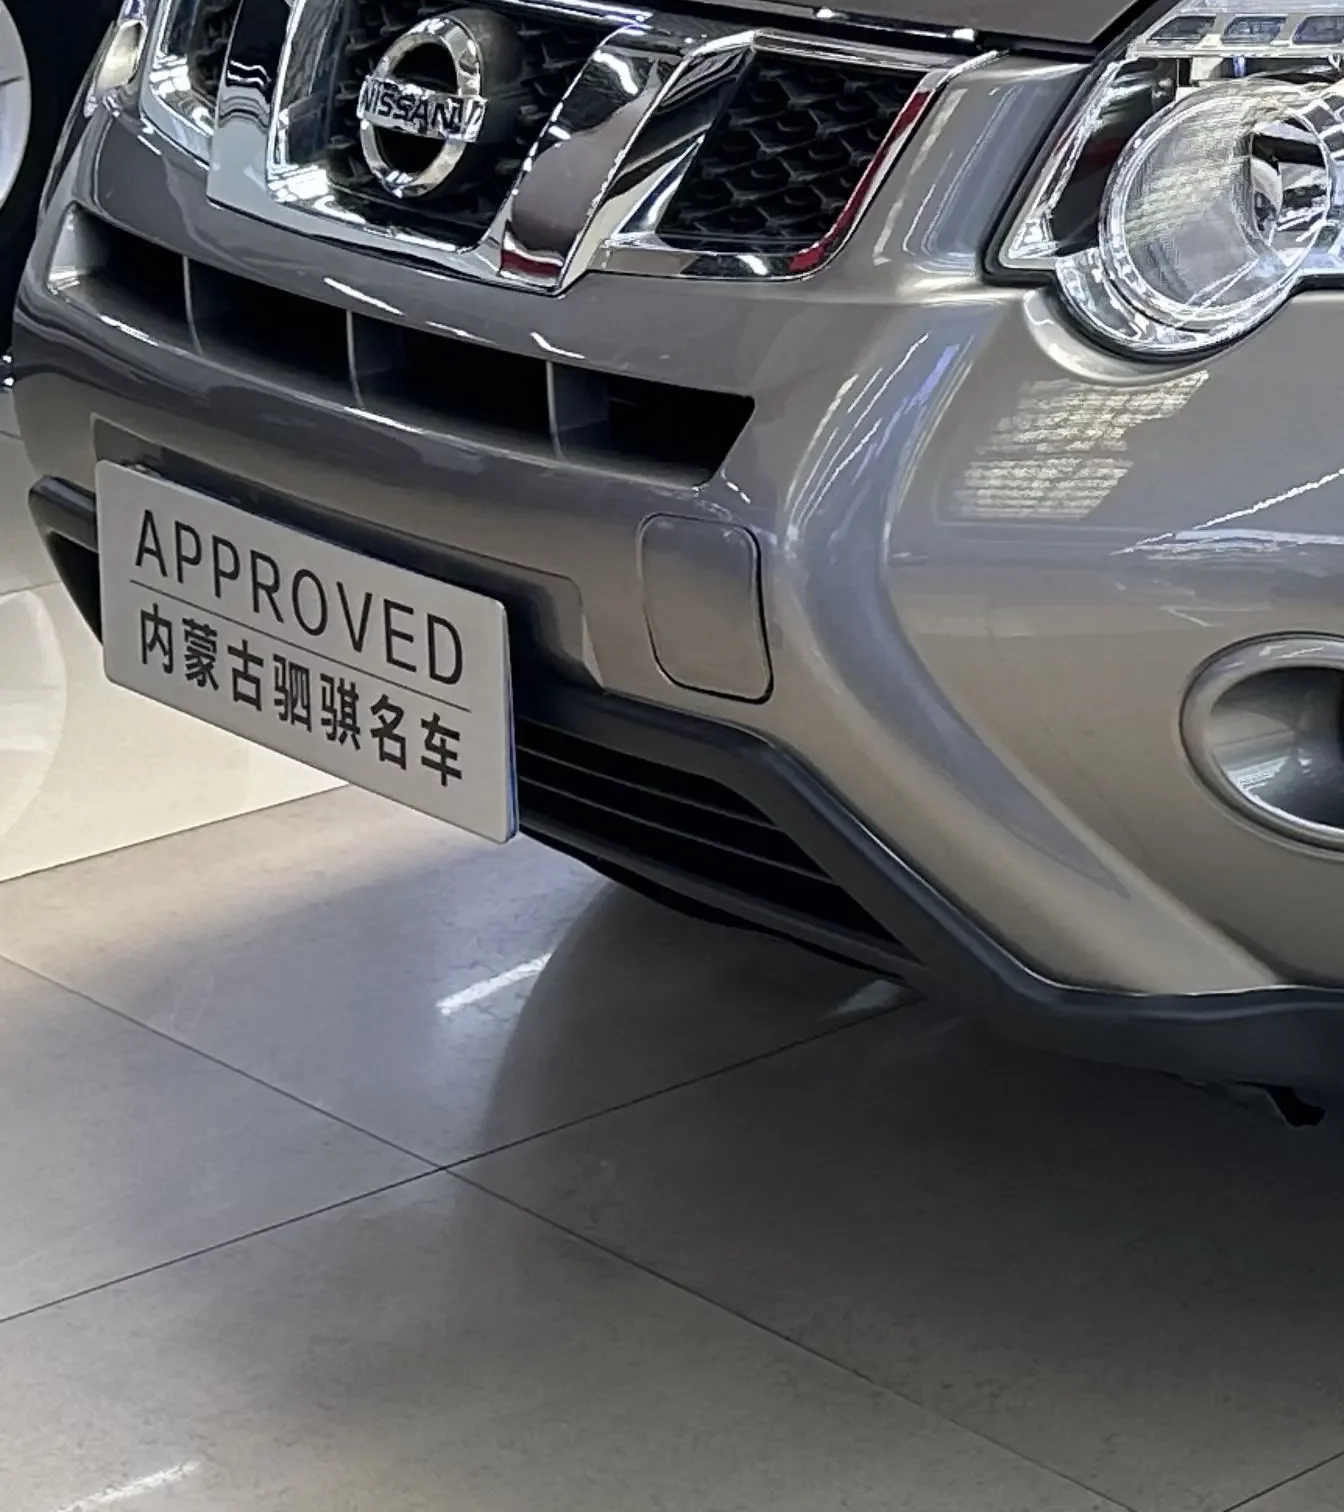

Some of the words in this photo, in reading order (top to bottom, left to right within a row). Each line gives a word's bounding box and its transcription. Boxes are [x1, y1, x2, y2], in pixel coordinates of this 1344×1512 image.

[361, 76, 464, 136] NISSAN
[134, 509, 464, 685] APPROVED
[140, 602, 463, 787] 内蒙古驷骐名车
